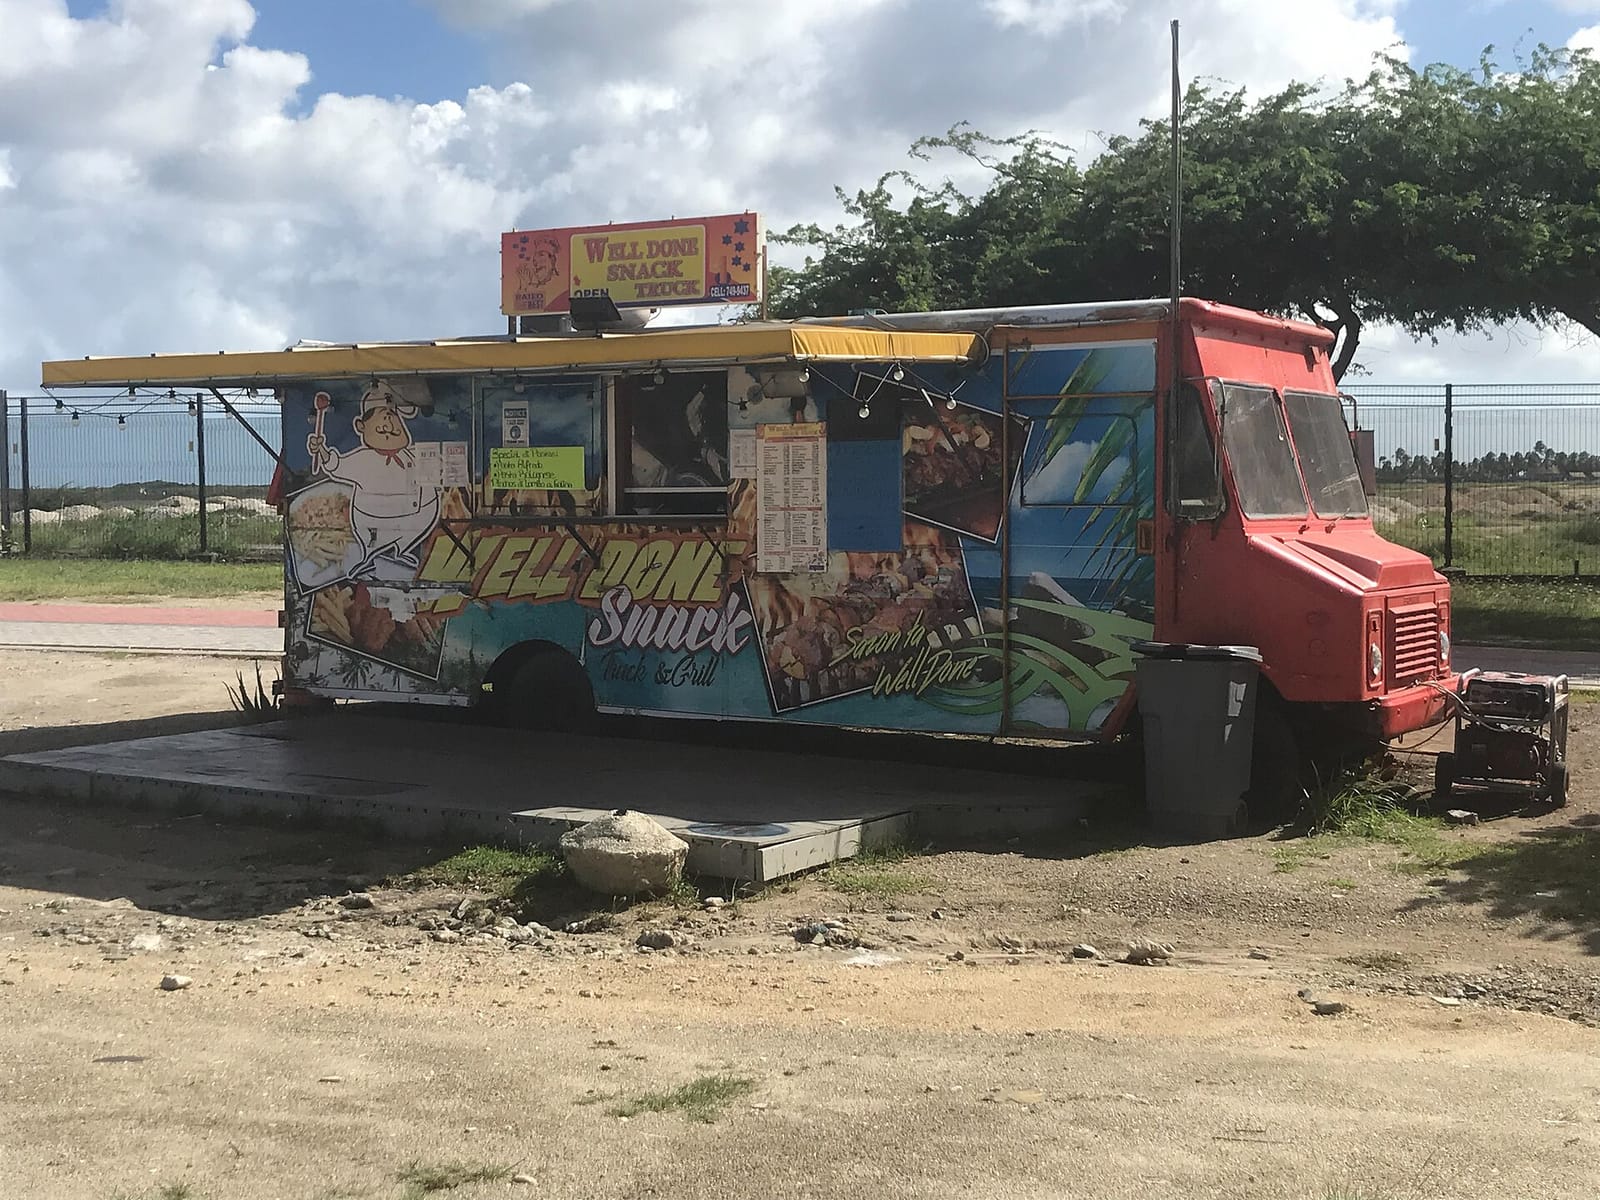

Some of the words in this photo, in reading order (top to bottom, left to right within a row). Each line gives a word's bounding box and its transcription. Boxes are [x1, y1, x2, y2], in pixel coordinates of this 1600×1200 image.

[583, 237, 643, 263] WELL
[646, 238, 698, 259] DONE
[607, 259, 683, 281] SNACK
[574, 288, 609, 298] OPEN
[634, 280, 700, 298] TRUCK
[417, 531, 571, 612] WELL
[580, 538, 746, 601] DONE
[588, 585, 752, 652] Snack
[828, 626, 902, 667] Sazon
[600, 651, 648, 682] Truck
